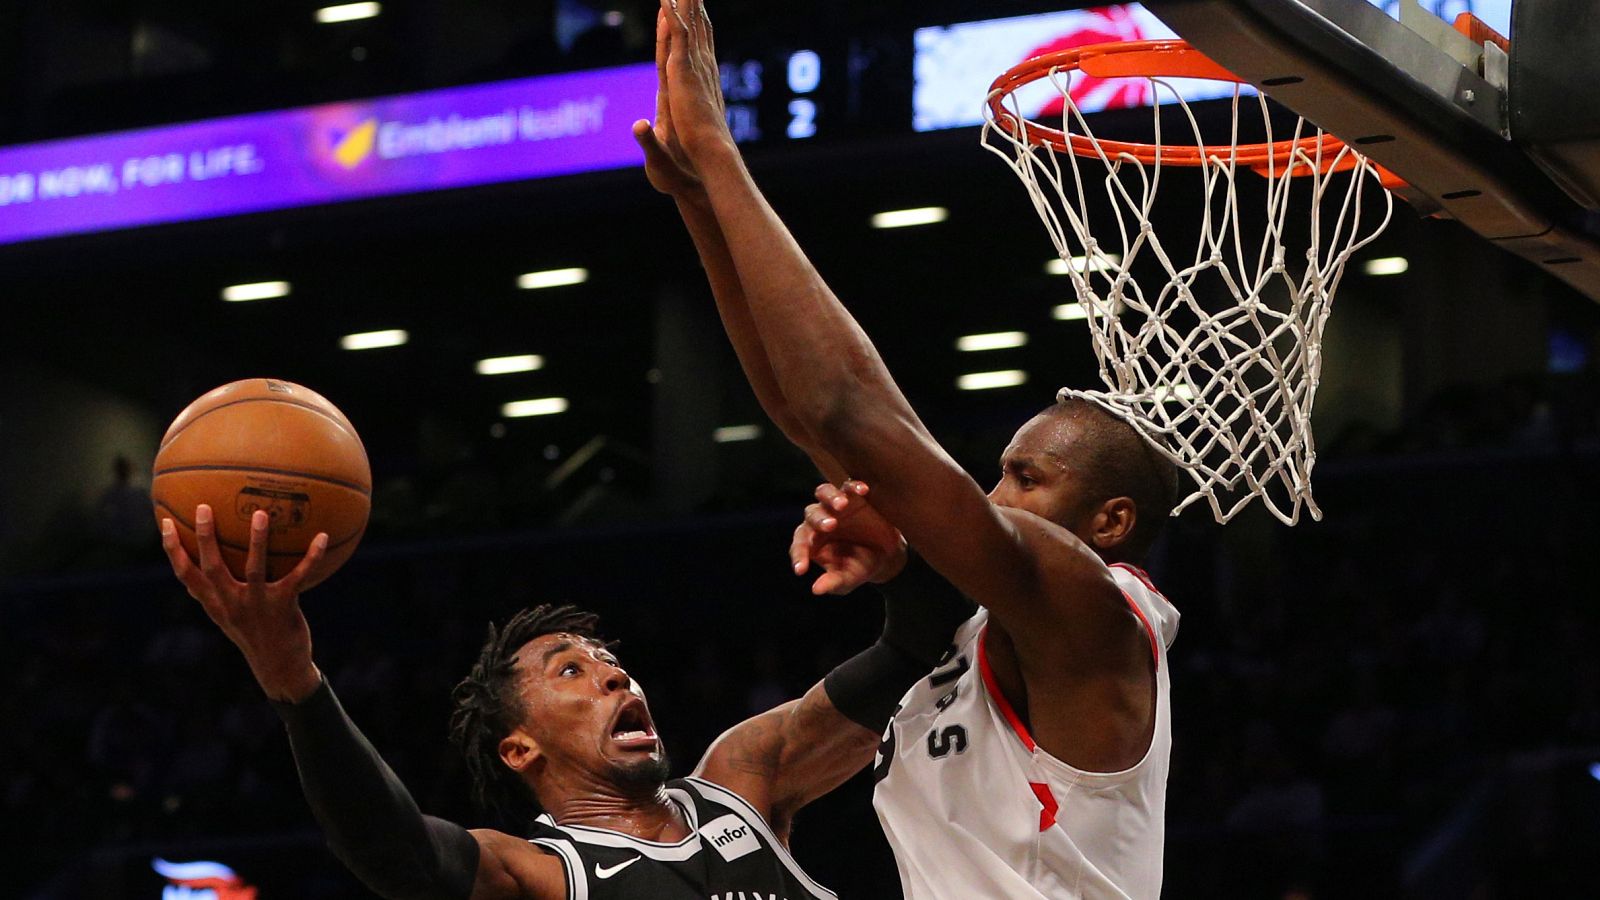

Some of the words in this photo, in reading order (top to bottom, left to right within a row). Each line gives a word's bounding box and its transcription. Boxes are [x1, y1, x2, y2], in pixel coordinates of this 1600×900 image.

[786, 49, 821, 94] 0
[785, 97, 818, 139] 2
[121, 152, 185, 190] FOR
[188, 143, 265, 182] LIFE.
[711, 825, 749, 848] infor
